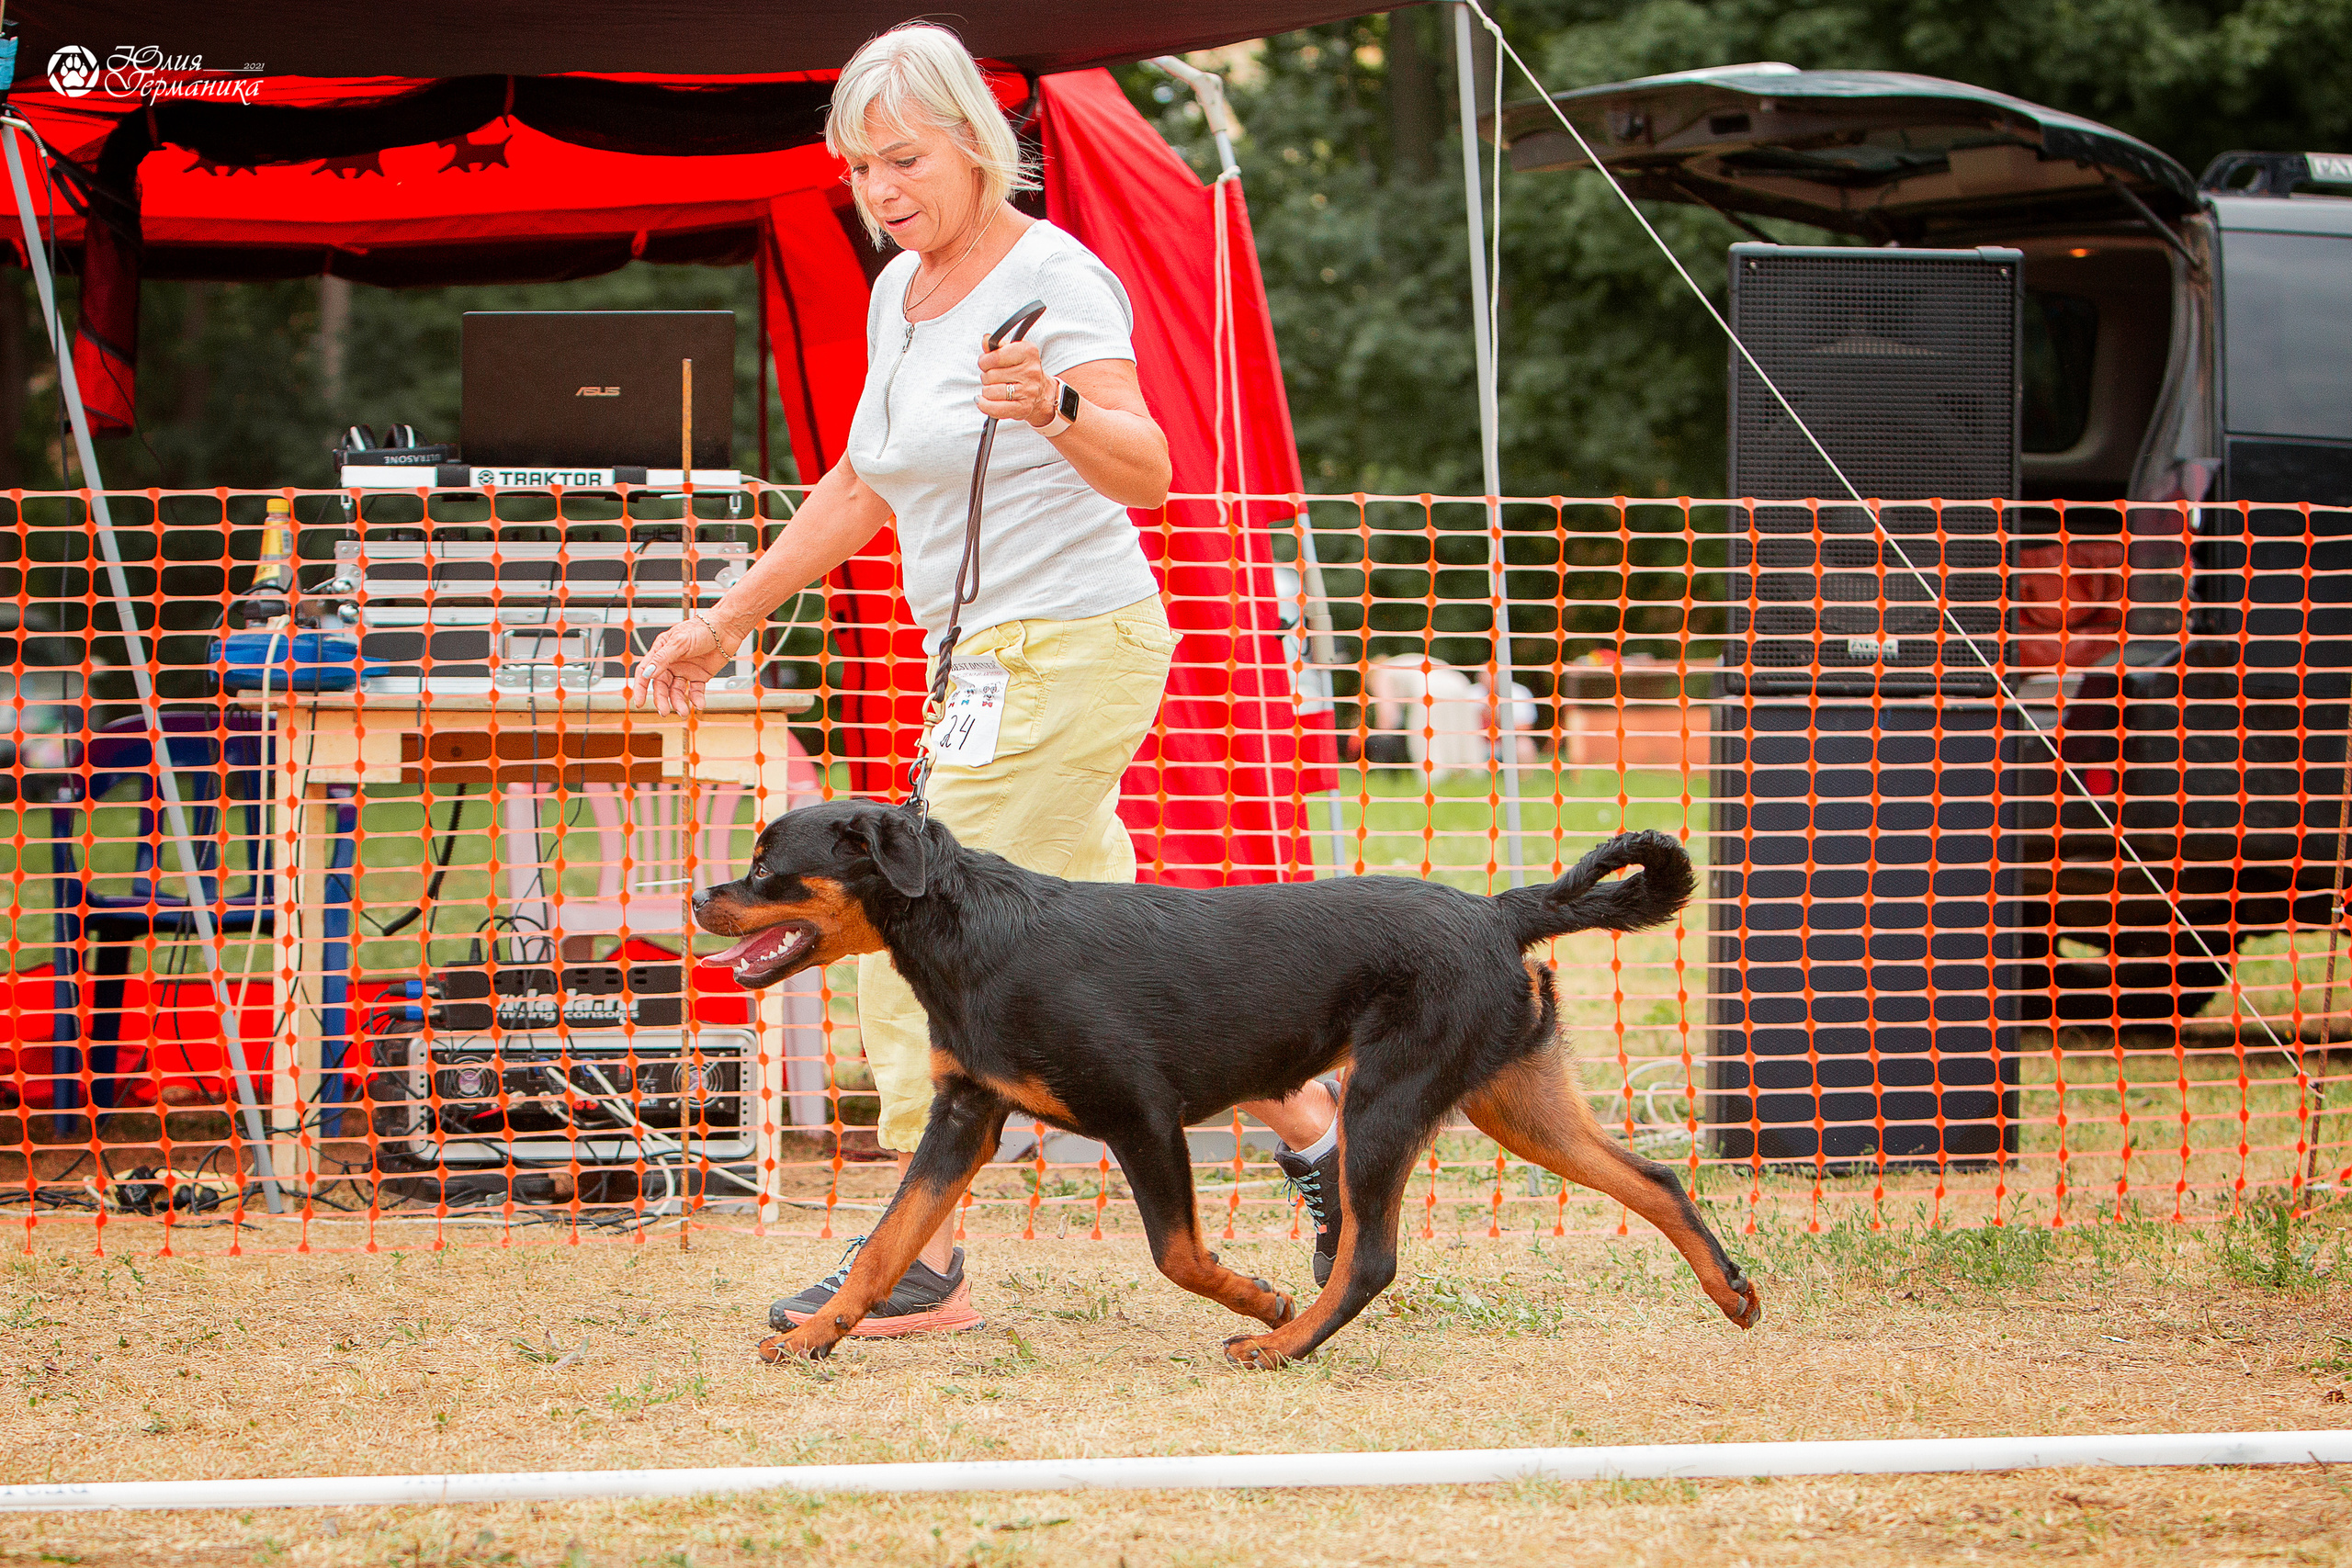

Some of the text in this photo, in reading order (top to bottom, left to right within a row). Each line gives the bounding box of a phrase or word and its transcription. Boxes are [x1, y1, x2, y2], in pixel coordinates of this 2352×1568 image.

[575, 386, 621, 397] ASUS
[384, 454, 442, 465] ULTRASONE
[499, 471, 602, 486] TRAKTOR
[940, 714, 976, 750] 24
